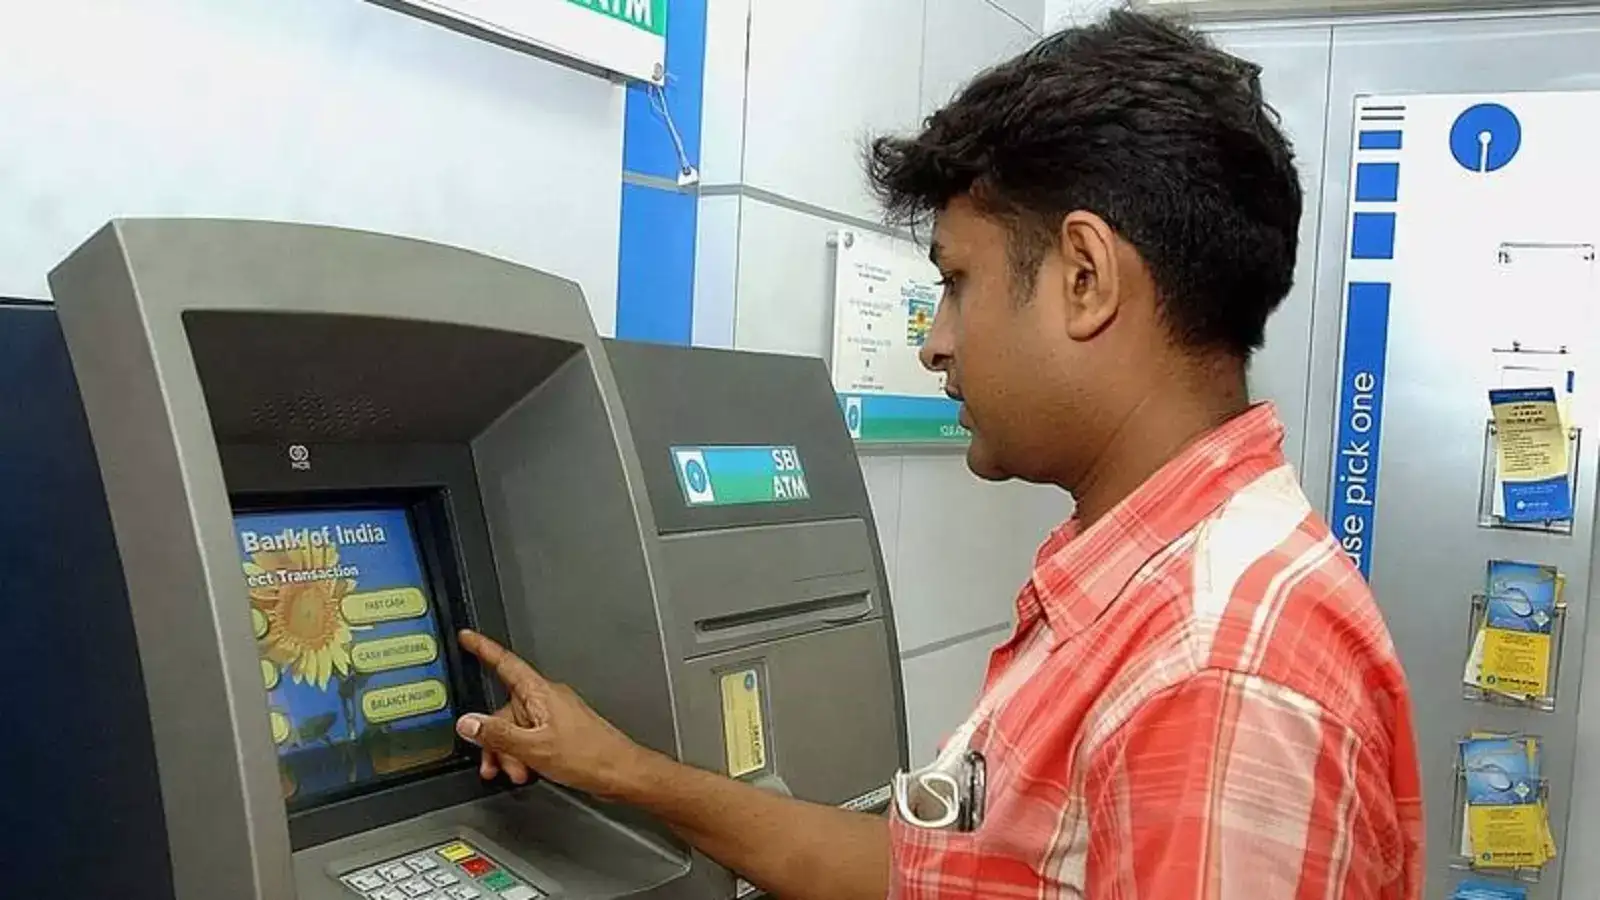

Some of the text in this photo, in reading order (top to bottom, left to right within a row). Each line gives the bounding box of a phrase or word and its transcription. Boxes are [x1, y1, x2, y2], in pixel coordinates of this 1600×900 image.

[1351, 371, 1375, 432] one
[771, 449, 801, 471] SBI
[1340, 440, 1373, 505] pick
[773, 476, 810, 499] ATM
[240, 522, 386, 553] Bank of India
[277, 564, 360, 583] Transaction
